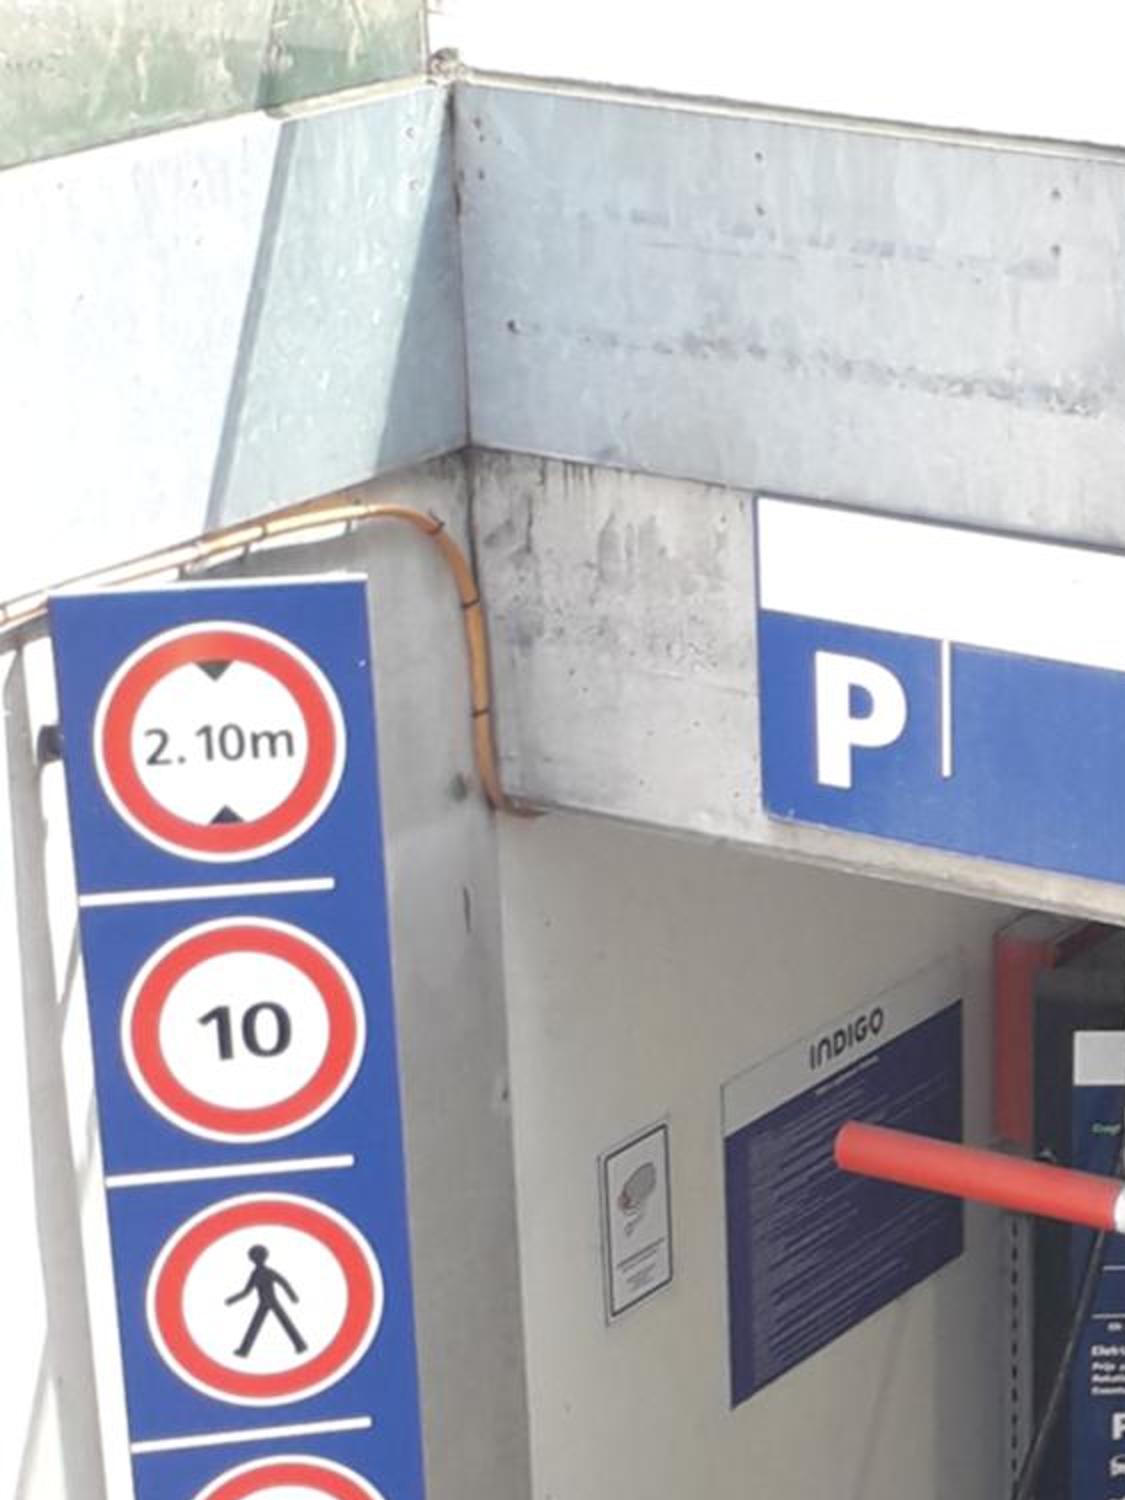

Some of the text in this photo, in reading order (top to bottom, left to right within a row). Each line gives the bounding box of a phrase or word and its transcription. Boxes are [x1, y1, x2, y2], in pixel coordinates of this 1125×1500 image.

[815, 650, 907, 789] P
[197, 1001, 292, 1060] 10
[809, 1007, 884, 1069] INDIGO
